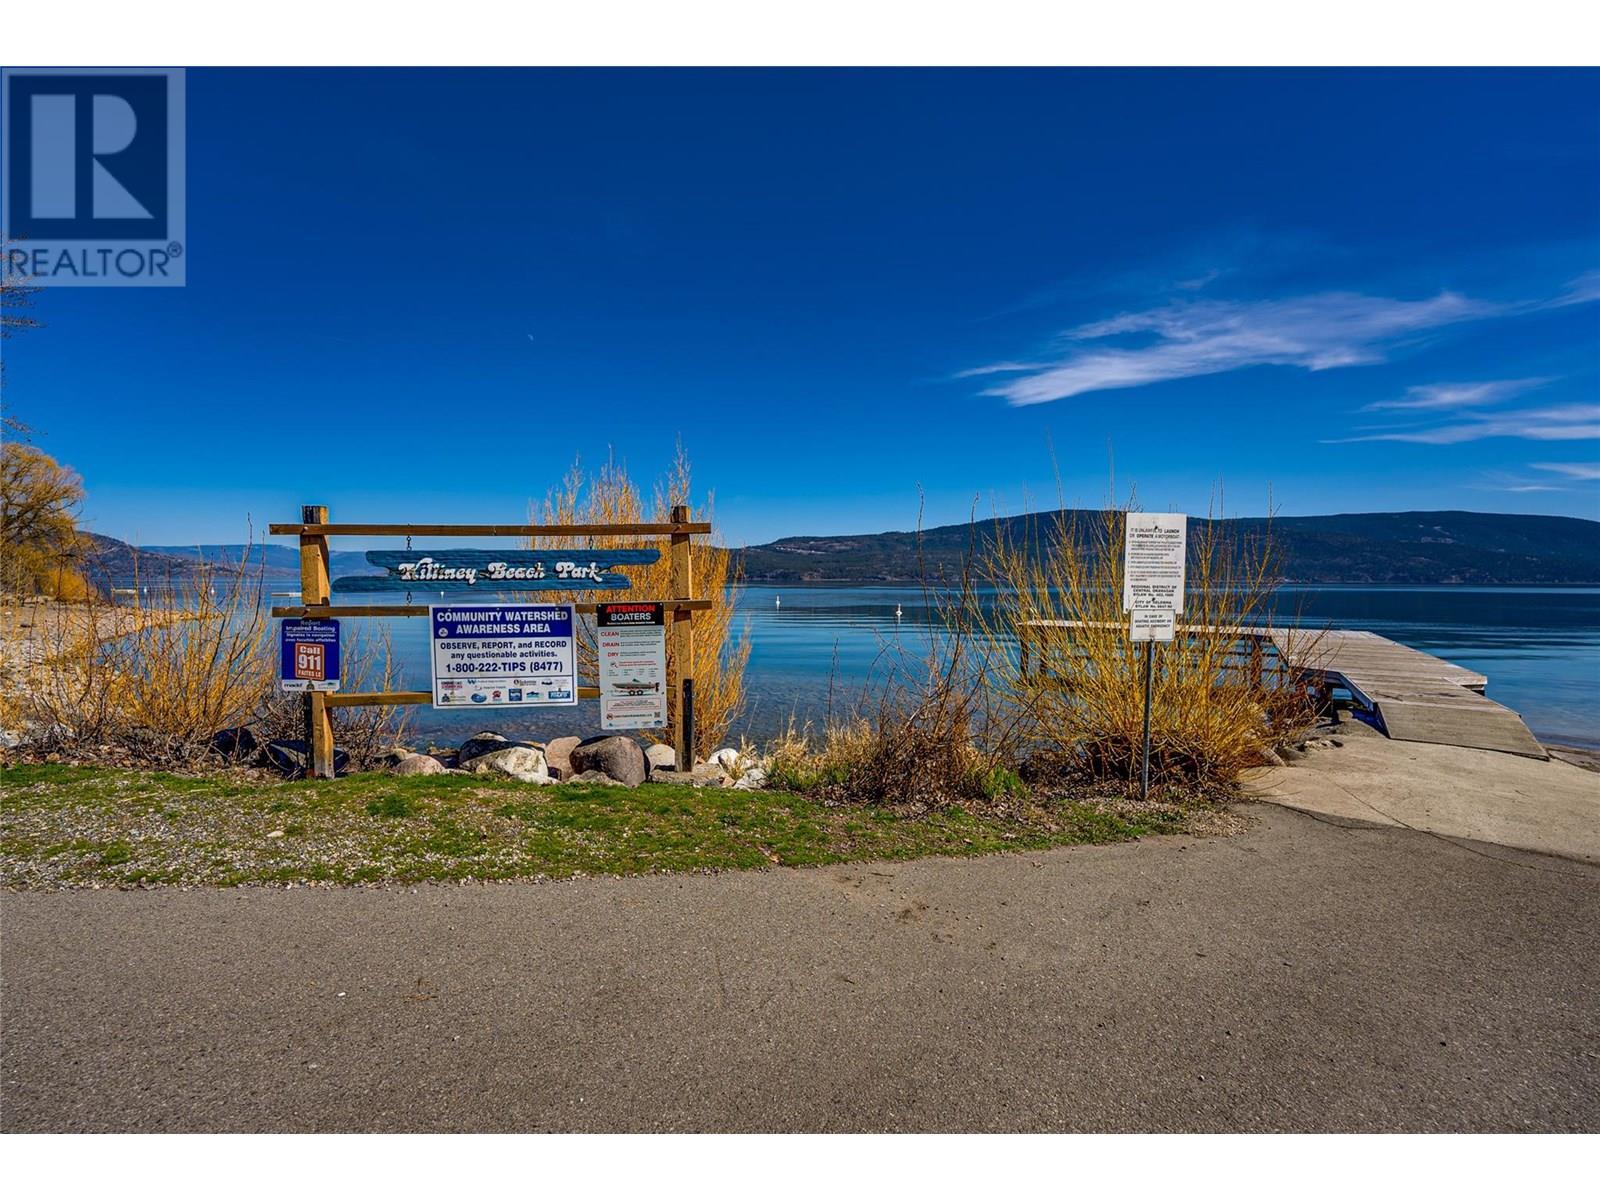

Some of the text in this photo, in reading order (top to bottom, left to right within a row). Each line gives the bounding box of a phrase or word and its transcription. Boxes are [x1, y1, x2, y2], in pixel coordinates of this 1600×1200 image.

[397, 557, 604, 584] Killiney Beach Park
[606, 605, 656, 614] ATTENTION
[437, 611, 568, 623] COMMUNITY WATERSHED
[611, 613, 652, 622] BOATERS
[456, 623, 551, 634] AWARENESS AREA
[440, 642, 480, 650] OBSERVE,
[482, 641, 516, 650] REPORT,
[535, 640, 567, 648] RECORD
[300, 646, 321, 655] Call
[451, 650, 558, 660] any questionable activities.
[298, 654, 321, 670] 911
[446, 661, 563, 673] 1-800-222-TIPS (8477)
